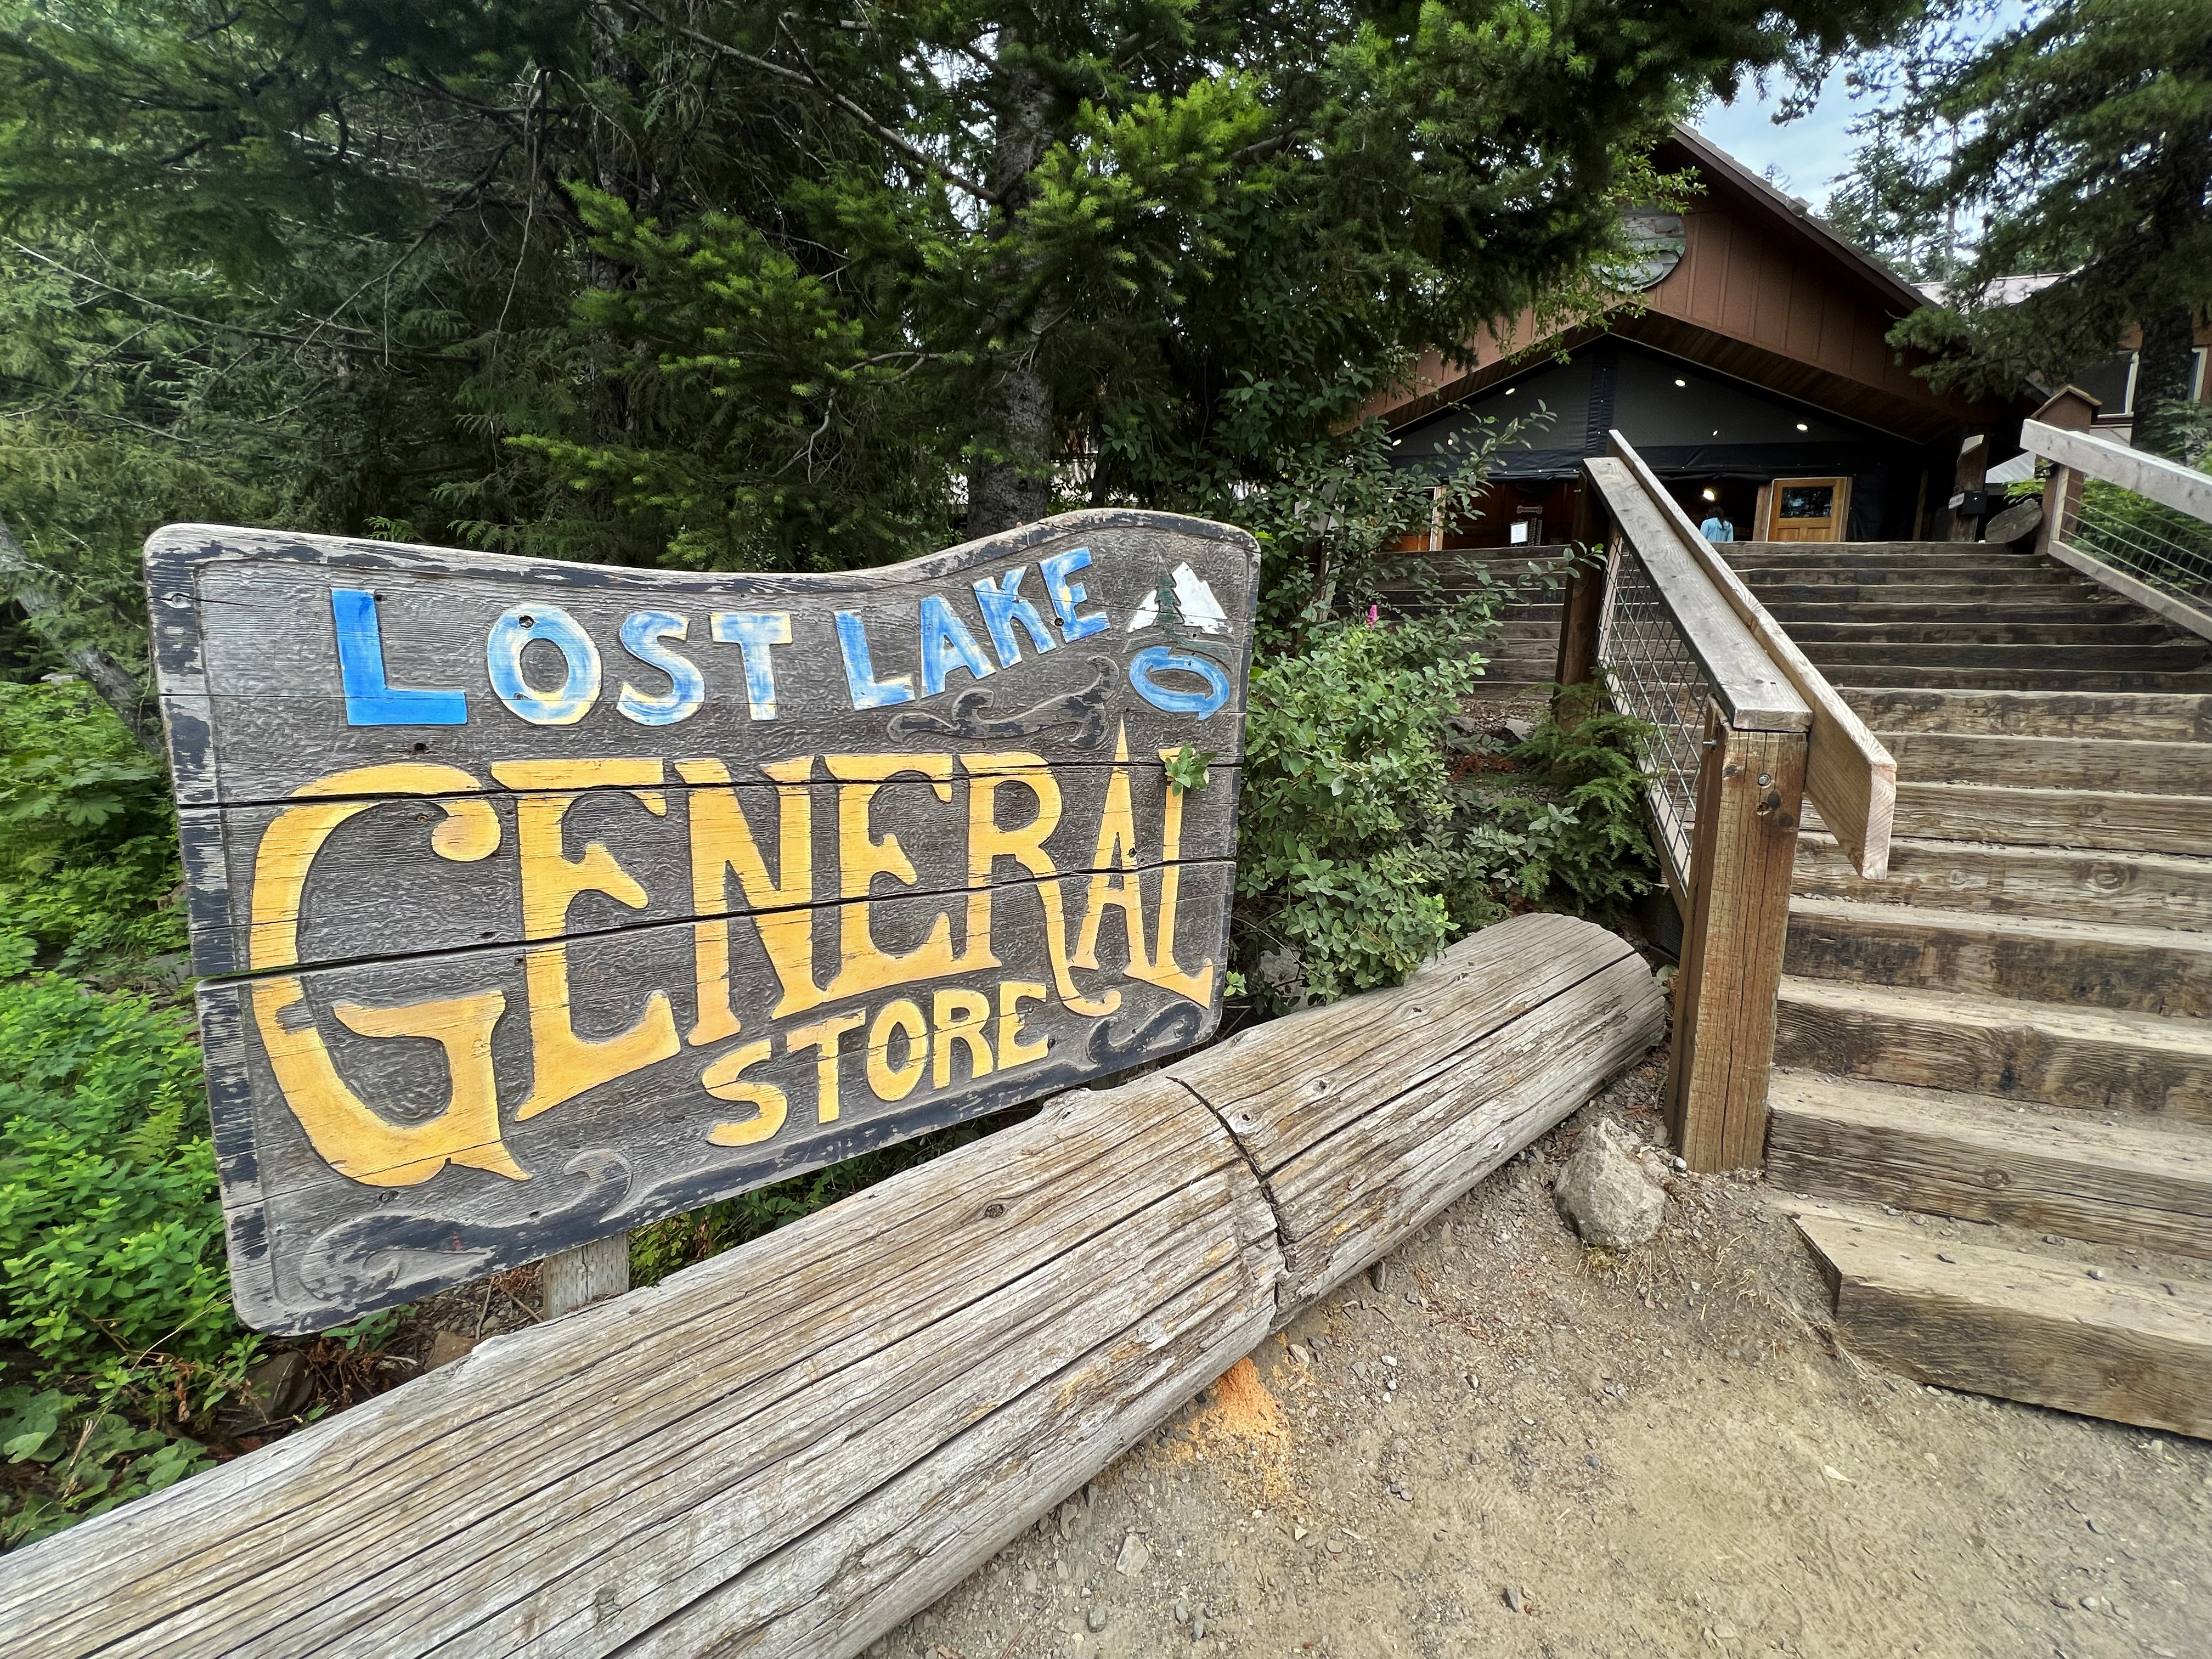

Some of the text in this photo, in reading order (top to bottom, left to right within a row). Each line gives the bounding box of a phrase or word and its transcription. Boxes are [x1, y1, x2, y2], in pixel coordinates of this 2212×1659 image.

[332, 549, 1109, 726] LOST LAKE
[249, 719, 1213, 1187] GENERAL
[703, 983, 1051, 1147] STORE
